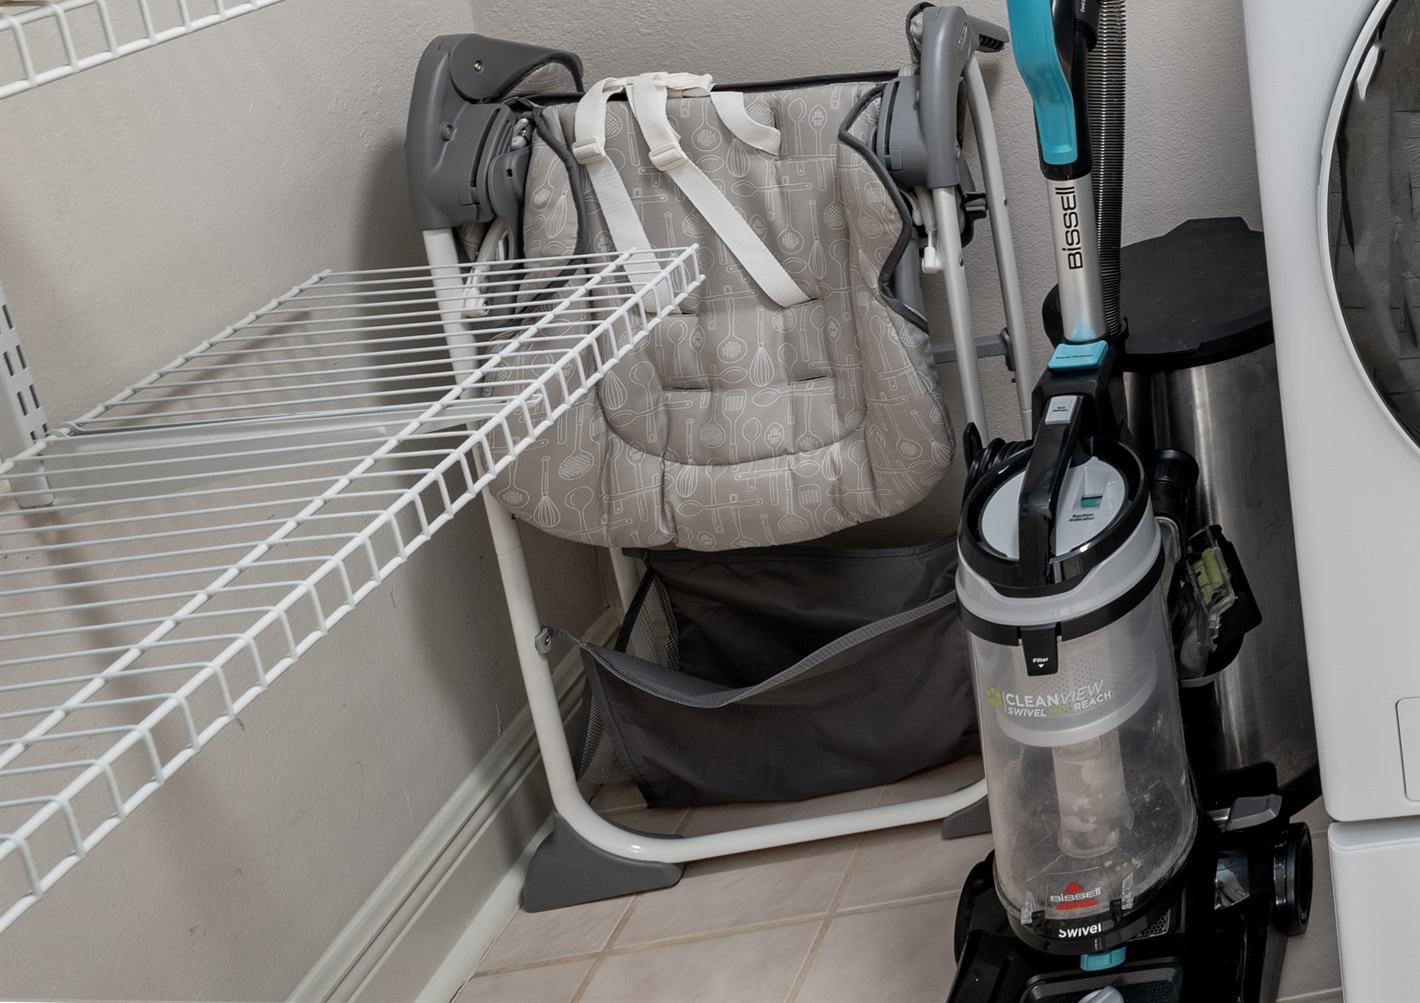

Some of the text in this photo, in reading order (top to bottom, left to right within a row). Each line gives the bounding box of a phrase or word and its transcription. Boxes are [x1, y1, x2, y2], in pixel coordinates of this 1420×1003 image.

[1006, 679, 1104, 707] CLEANVIEW
[1008, 707, 1047, 716] SWIVEL
[1073, 690, 1111, 711] REACH
[1058, 923, 1101, 938] Swivel
